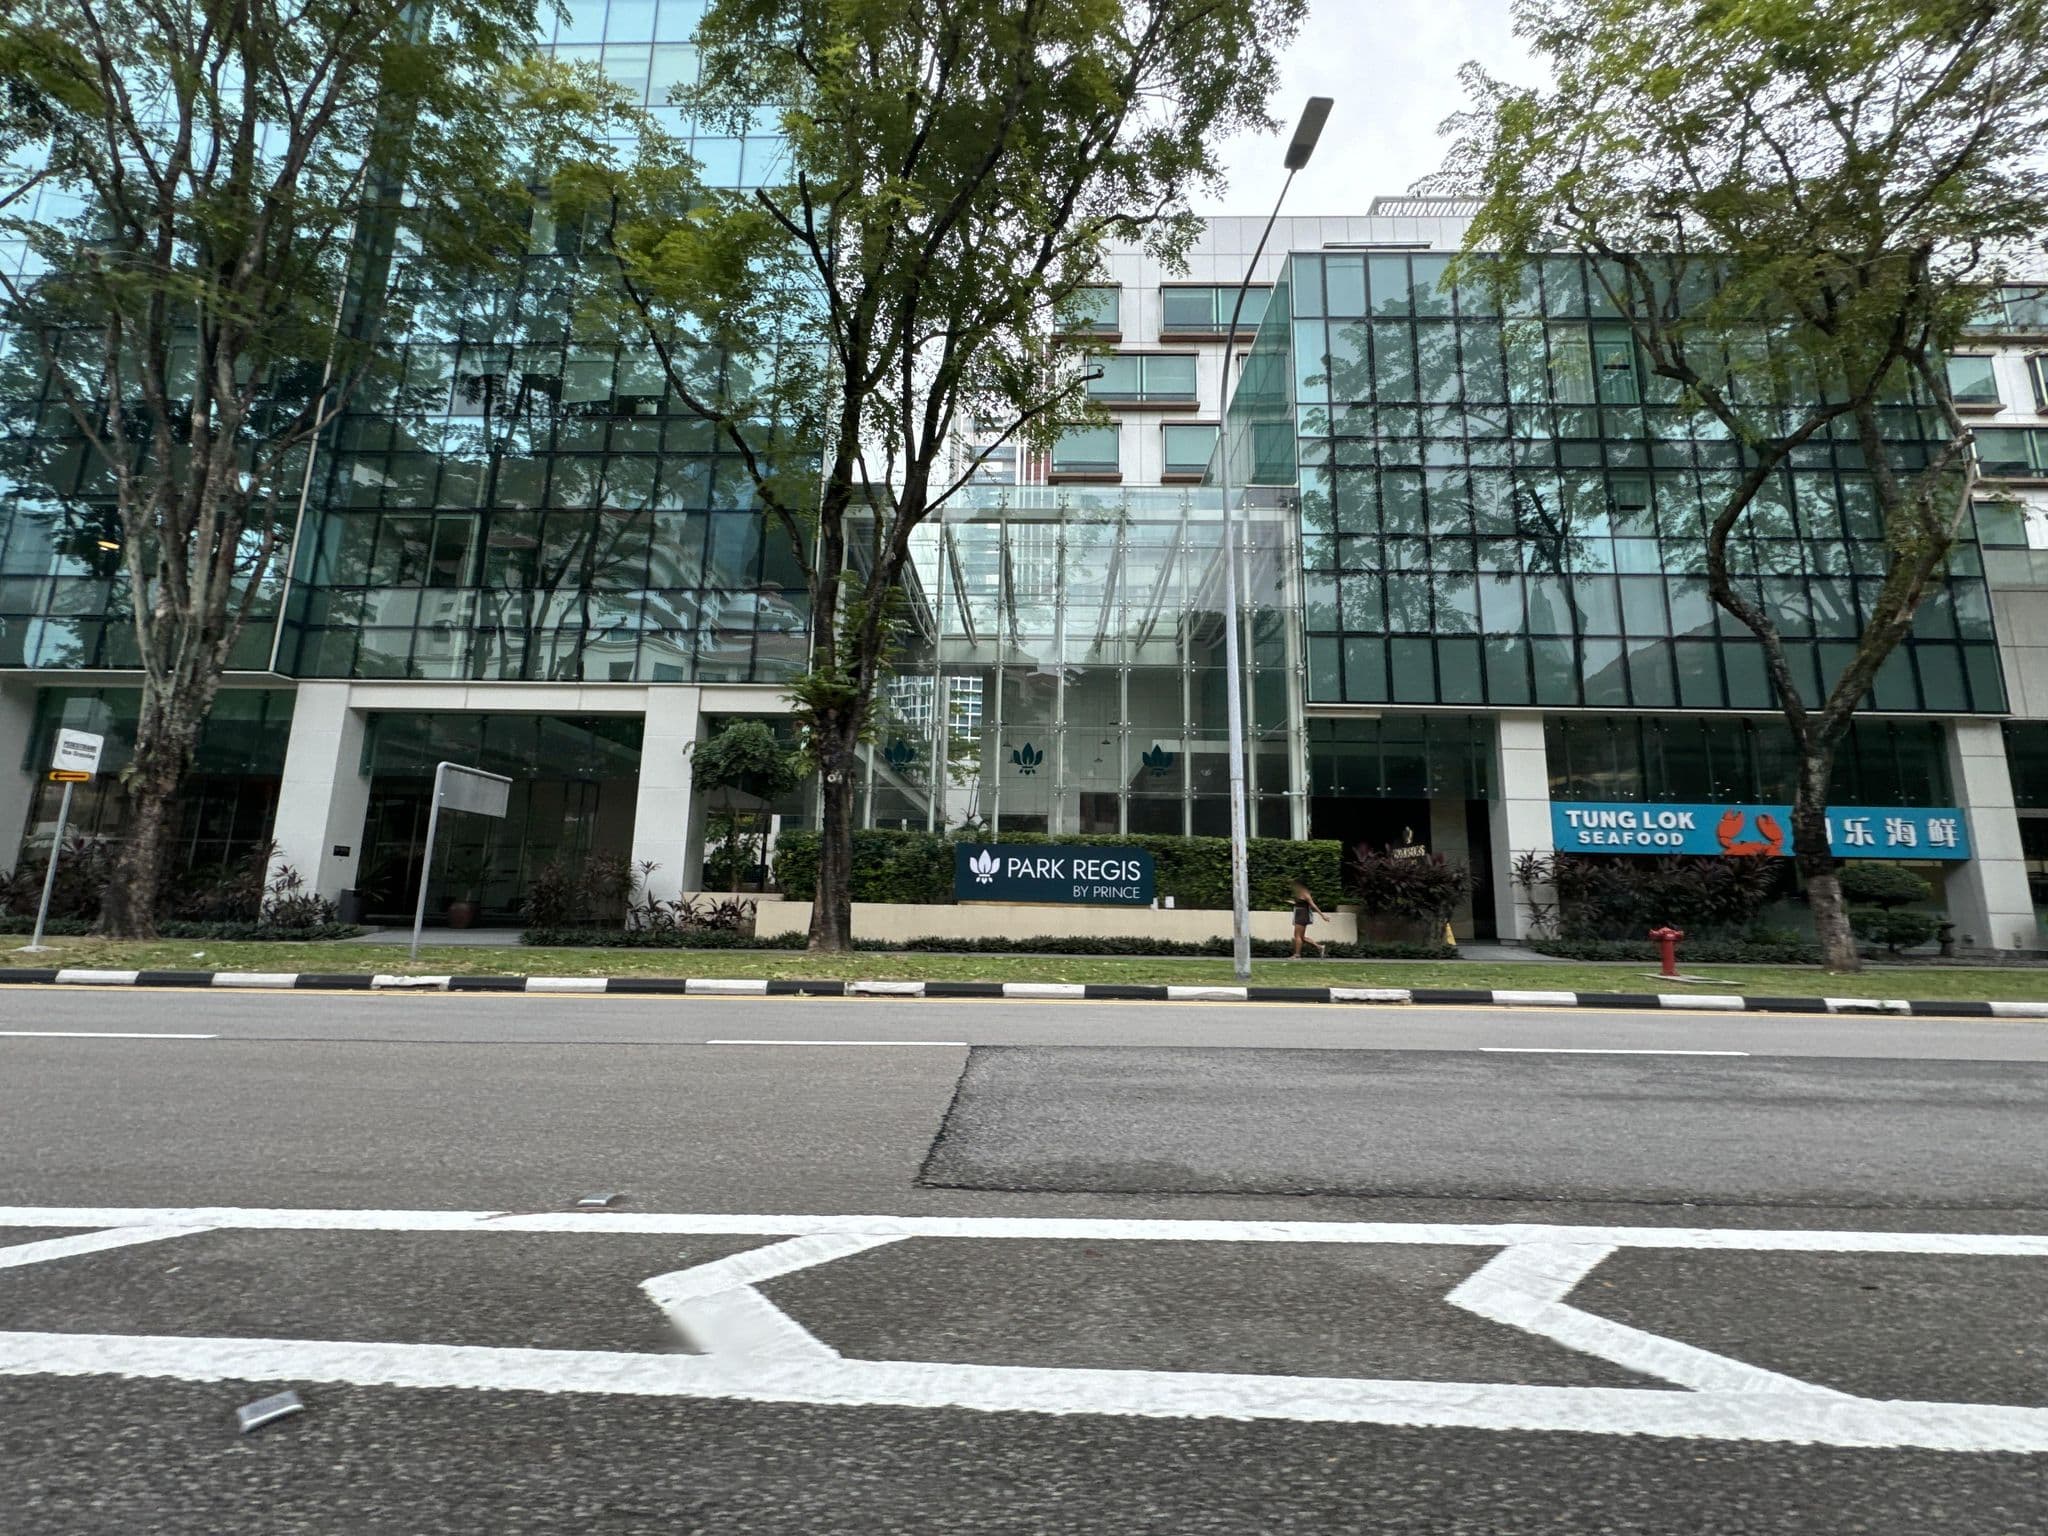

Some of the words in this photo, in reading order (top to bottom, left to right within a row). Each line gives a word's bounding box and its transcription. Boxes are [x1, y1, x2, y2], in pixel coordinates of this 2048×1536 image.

[1565, 809, 1637, 829] TUNG
[1643, 811, 1696, 830] LOK
[1578, 830, 1685, 846] SEAFOOD
[1825, 816, 1960, 848] 乐海鲜
[1007, 857, 1065, 879] PARK
[1073, 859, 1141, 881] REGIS
[1073, 885, 1090, 898] BY
[1093, 886, 1141, 899] PRINCE
